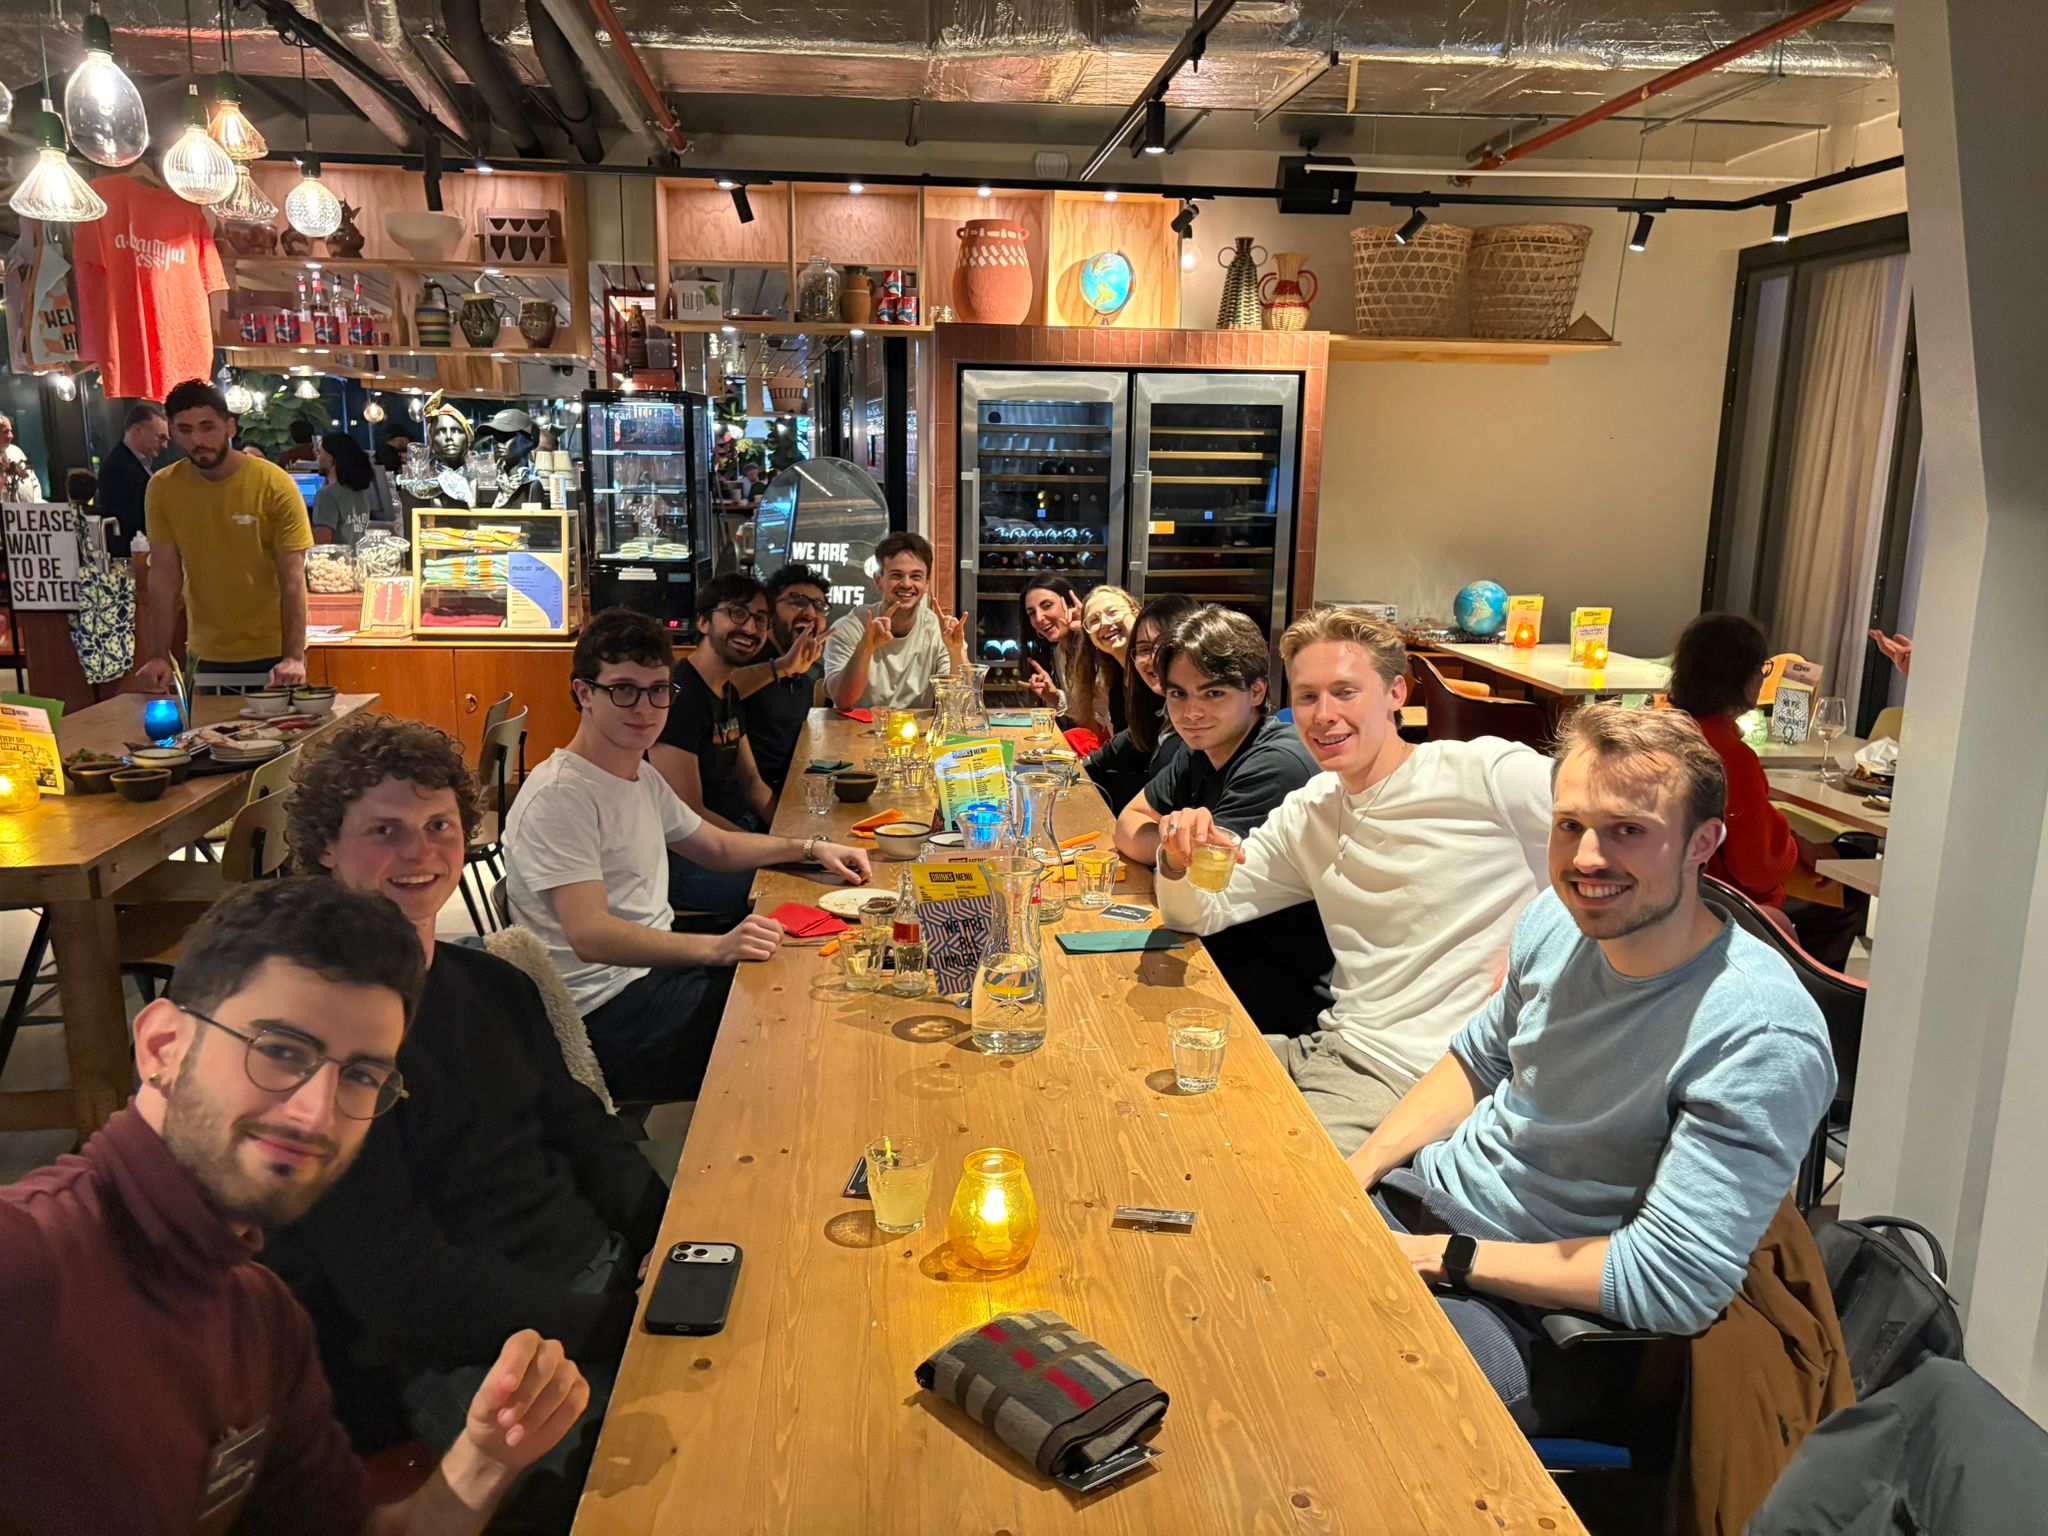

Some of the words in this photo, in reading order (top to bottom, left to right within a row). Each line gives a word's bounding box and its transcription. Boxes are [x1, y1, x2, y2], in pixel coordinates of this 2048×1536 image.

[4, 509, 74, 532] PLEASE
[6, 533, 53, 555] WAIT
[792, 541, 815, 560] WE
[818, 542, 850, 567] ARE
[9, 557, 34, 579] TO
[38, 557, 63, 579] BE
[929, 872, 956, 882] DRINKS
[955, 873, 974, 881] MENU
[943, 919, 961, 935] WE
[962, 916, 985, 932] ARE
